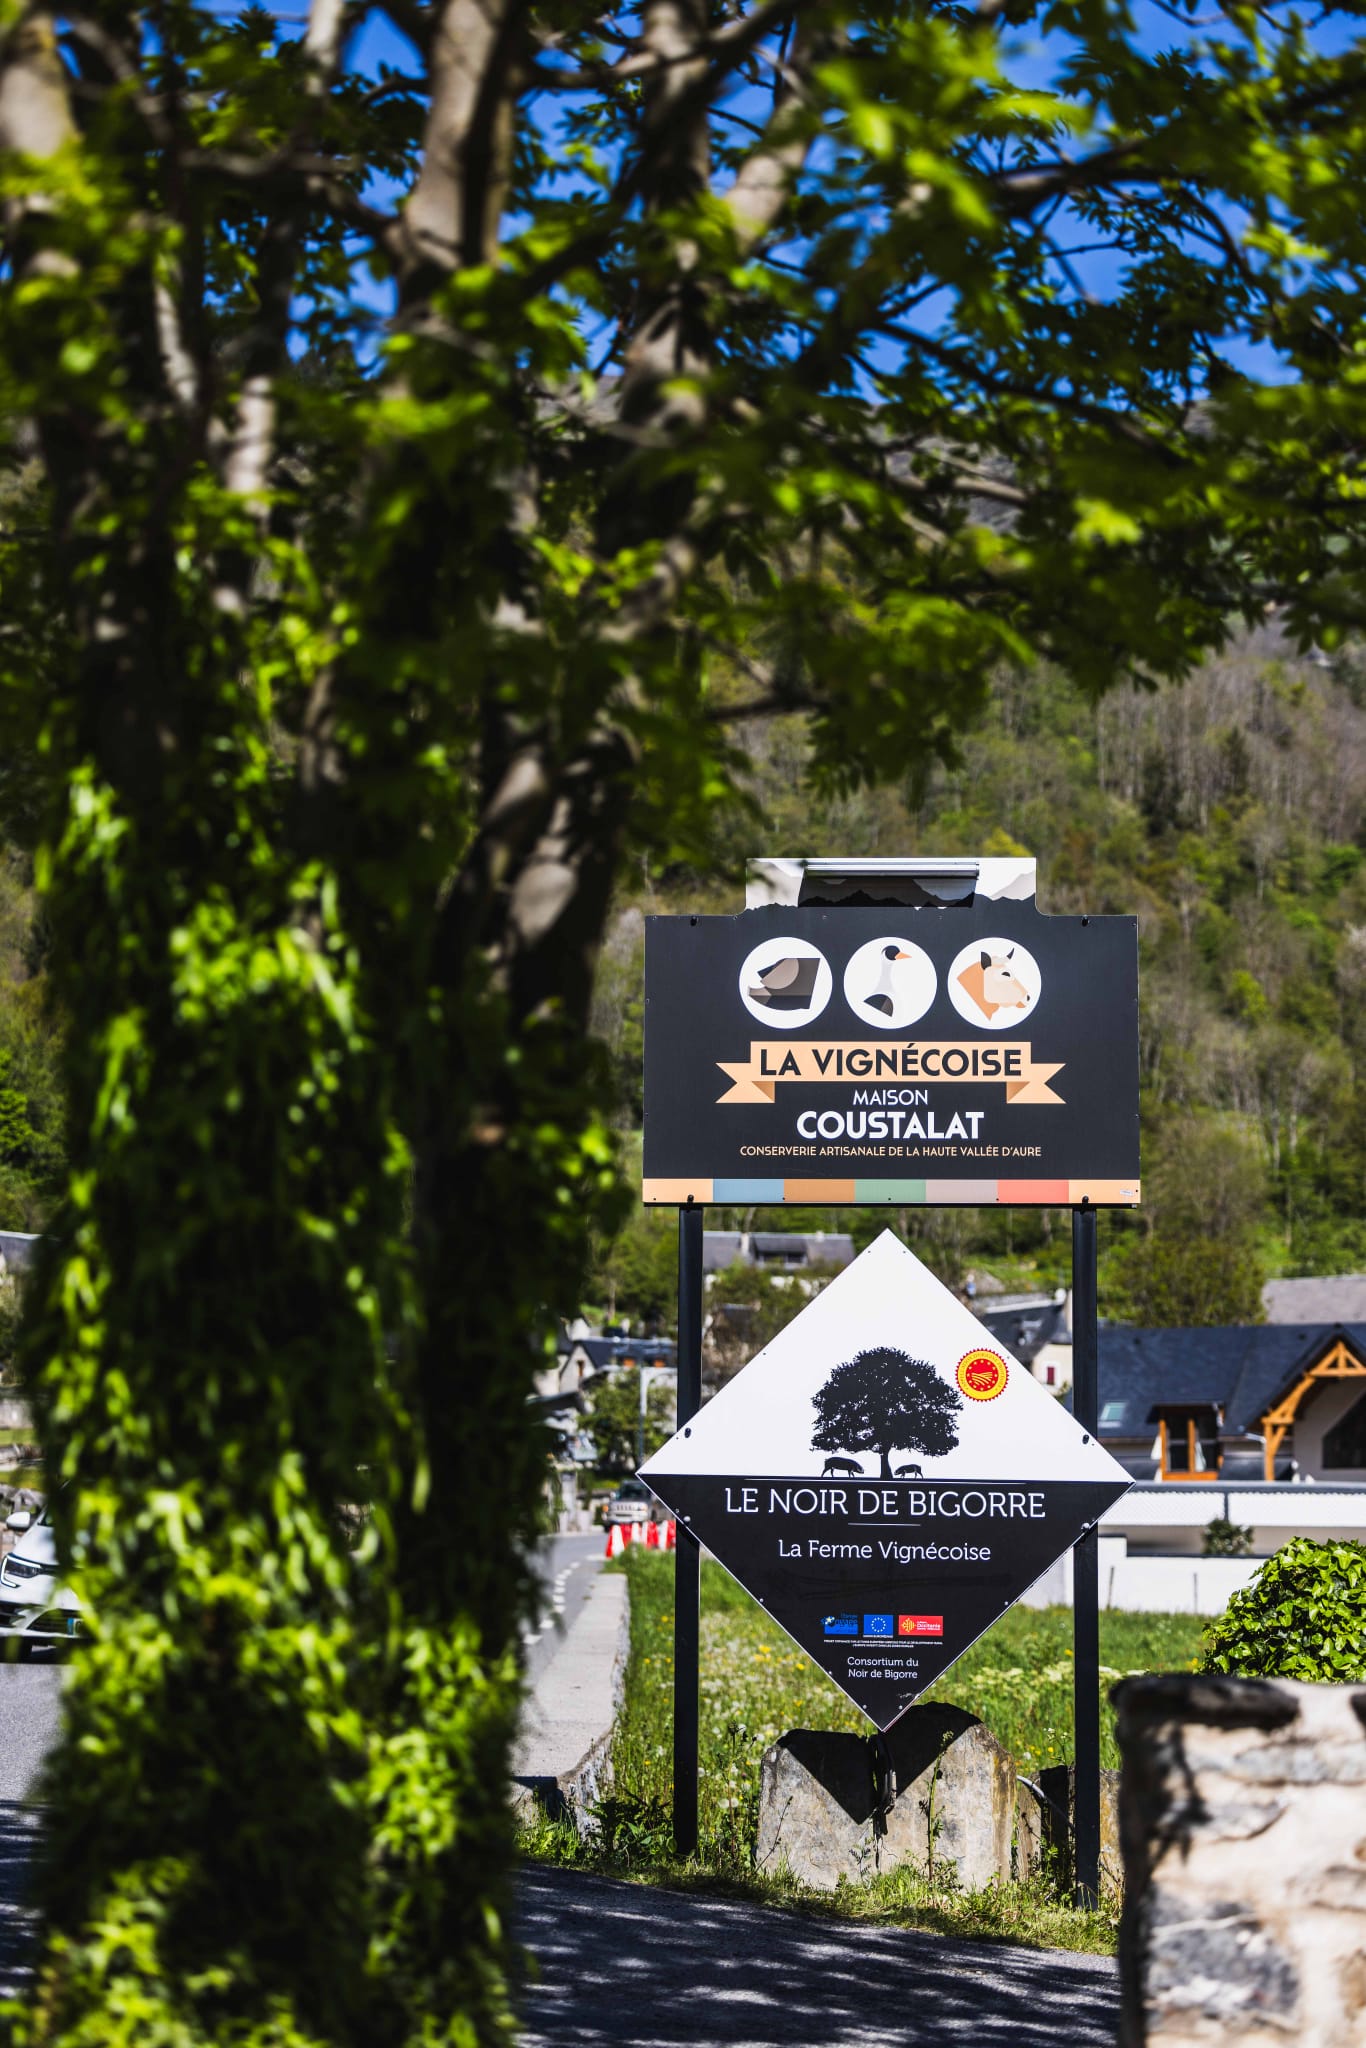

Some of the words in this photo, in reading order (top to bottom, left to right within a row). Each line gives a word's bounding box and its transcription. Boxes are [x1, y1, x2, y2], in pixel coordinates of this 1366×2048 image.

[761, 1049, 801, 1075] LA
[812, 1043, 1022, 1076] VIGNÉCOISE
[853, 1089, 928, 1105] MAISON
[797, 1111, 984, 1139] COUSTALAT
[740, 1146, 817, 1156] CONSERVERIE
[819, 1146, 886, 1156] ARTISANALE
[888, 1146, 904, 1156] DE
[906, 1146, 920, 1156] LA
[922, 1146, 957, 1156] HAUTE
[960, 1145, 999, 1157] VALLÉE
[1001, 1146, 1042, 1157] D'AURE
[725, 1487, 759, 1513] LE
[768, 1488, 848, 1515] NOIR
[858, 1490, 899, 1515] DE
[908, 1490, 1046, 1518] BIGORRE
[778, 1539, 802, 1557] La
[808, 1540, 872, 1559] Ferme
[878, 1541, 991, 1564] Vignécoise
[847, 1656, 904, 1667] Consortium
[905, 1657, 919, 1667] du
[848, 1668, 868, 1678] Noir
[870, 1669, 882, 1678] de
[884, 1669, 918, 1681] Bigorre
